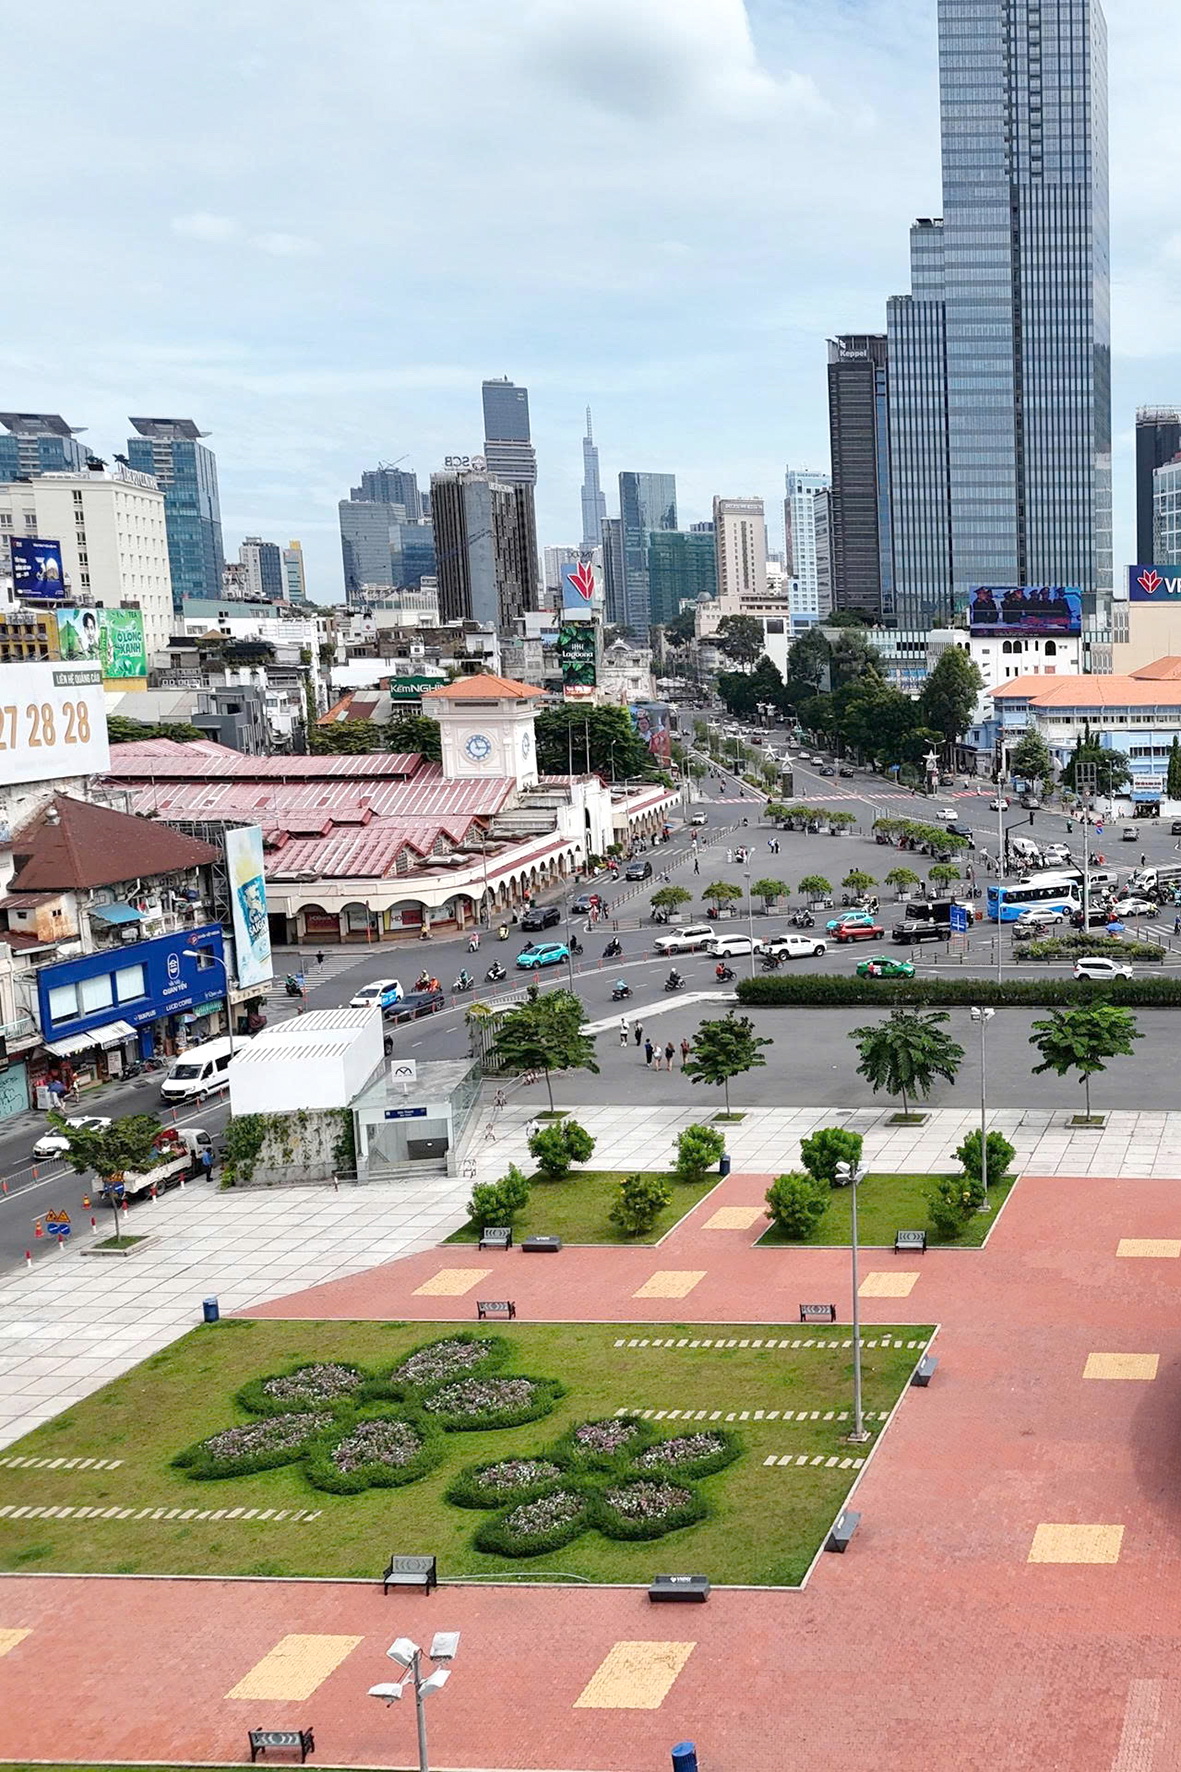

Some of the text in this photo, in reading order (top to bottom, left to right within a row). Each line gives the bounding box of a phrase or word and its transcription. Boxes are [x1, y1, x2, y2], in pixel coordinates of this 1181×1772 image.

[840, 350, 867, 358] Keppel
[26, 703, 55, 747] 28
[62, 701, 90, 744] 28
